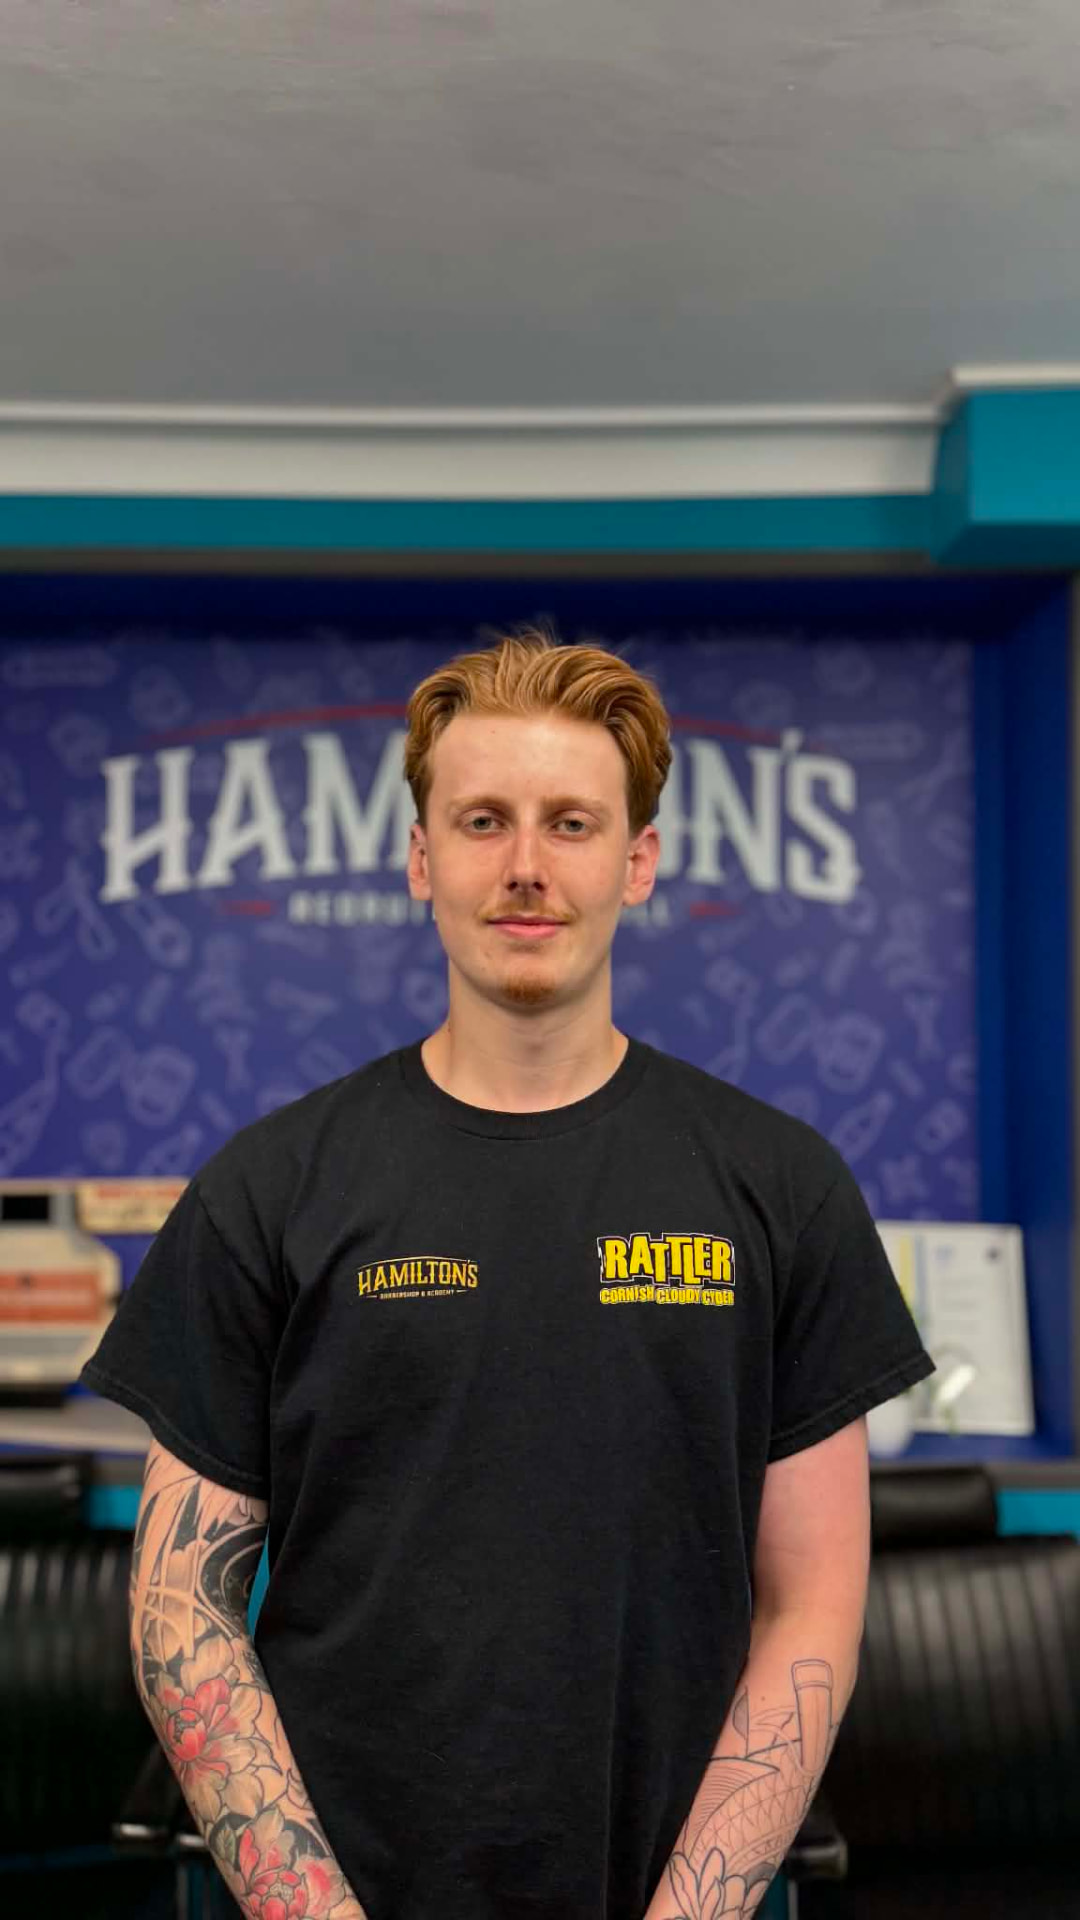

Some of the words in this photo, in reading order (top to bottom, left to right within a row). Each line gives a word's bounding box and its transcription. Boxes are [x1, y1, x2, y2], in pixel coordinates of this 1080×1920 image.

[358, 1260, 478, 1296] HAMILTON'S
[603, 1235, 732, 1285] RATTLER
[600, 1286, 655, 1304] CORNISH
[656, 1288, 701, 1304] CLOUDY
[702, 1289, 734, 1306] CYDER
